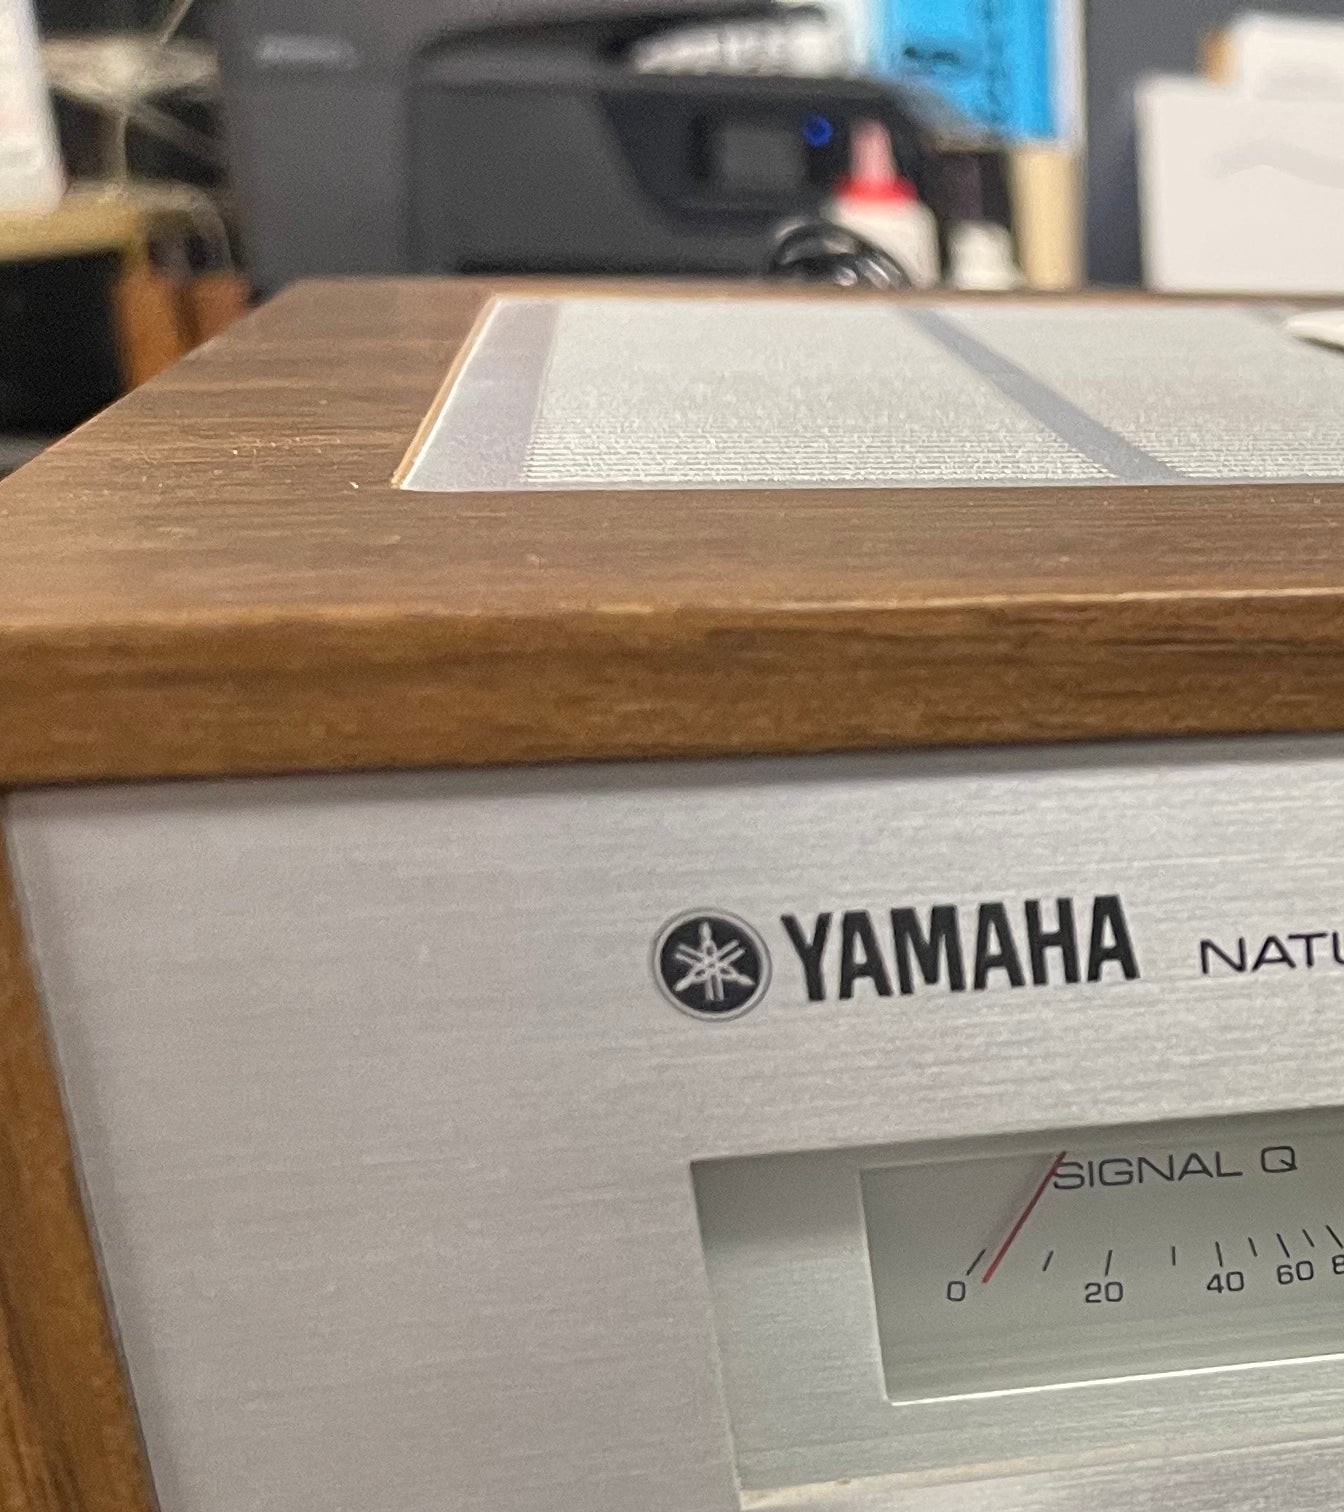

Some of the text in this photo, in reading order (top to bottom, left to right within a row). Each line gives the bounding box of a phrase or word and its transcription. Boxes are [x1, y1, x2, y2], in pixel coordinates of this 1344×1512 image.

[780, 895, 1140, 1003] YAMAHA
[1052, 1145, 1298, 1190] SIGNAL Q
[946, 1280, 966, 1302] 0
[1084, 1281, 1124, 1304] 20
[1206, 1271, 1245, 1294] 40
[1276, 1260, 1315, 1285] 60
